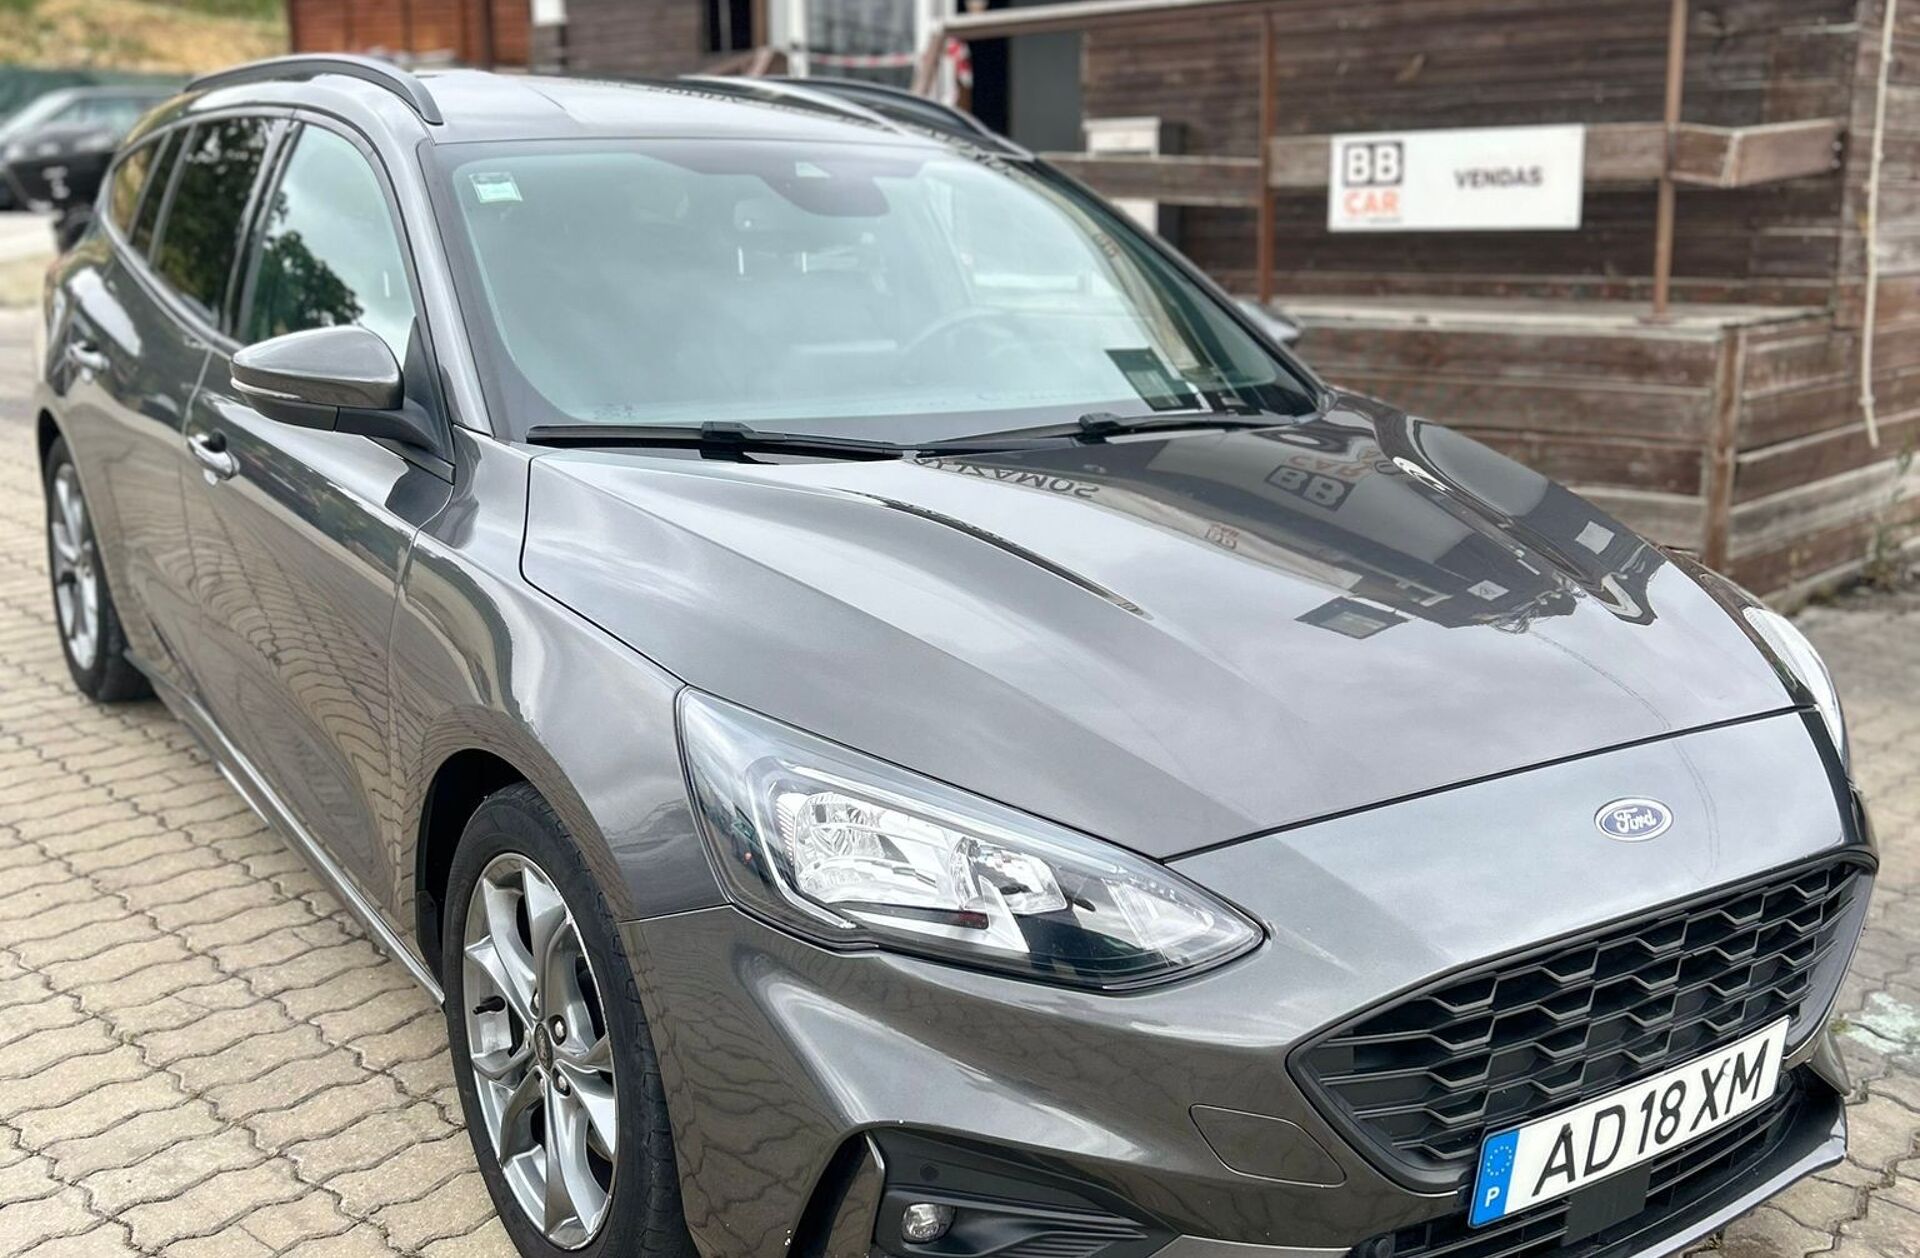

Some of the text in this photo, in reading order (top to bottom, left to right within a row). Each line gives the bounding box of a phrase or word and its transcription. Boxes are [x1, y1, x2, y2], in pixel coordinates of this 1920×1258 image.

[1344, 142, 1402, 187] BB
[1454, 167, 1543, 188] VENDAS
[1344, 190, 1400, 215] CAR
[1613, 807, 1657, 833] Ford
[1484, 1186, 1500, 1208] P
